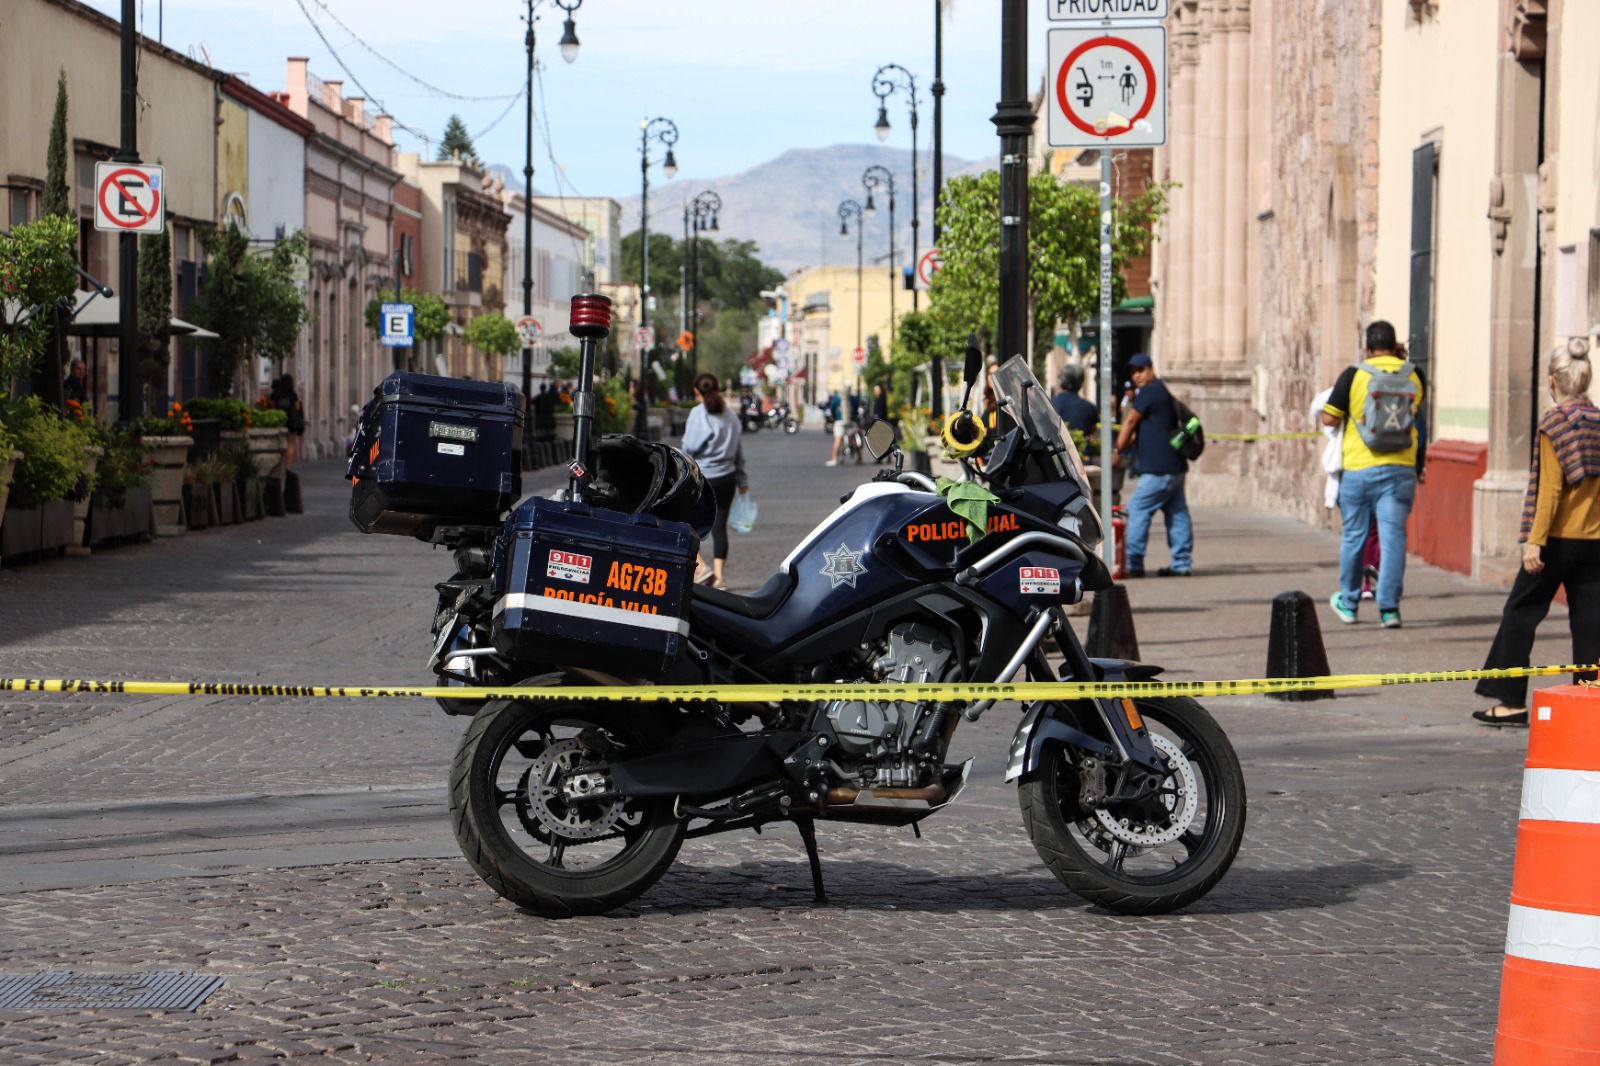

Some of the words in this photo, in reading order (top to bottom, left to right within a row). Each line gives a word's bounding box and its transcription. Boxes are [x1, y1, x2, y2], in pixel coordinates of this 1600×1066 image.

[391, 317, 404, 333] E
[552, 552, 588, 567] 911
[606, 560, 668, 597] AG73B
[1023, 569, 1056, 578] 911
